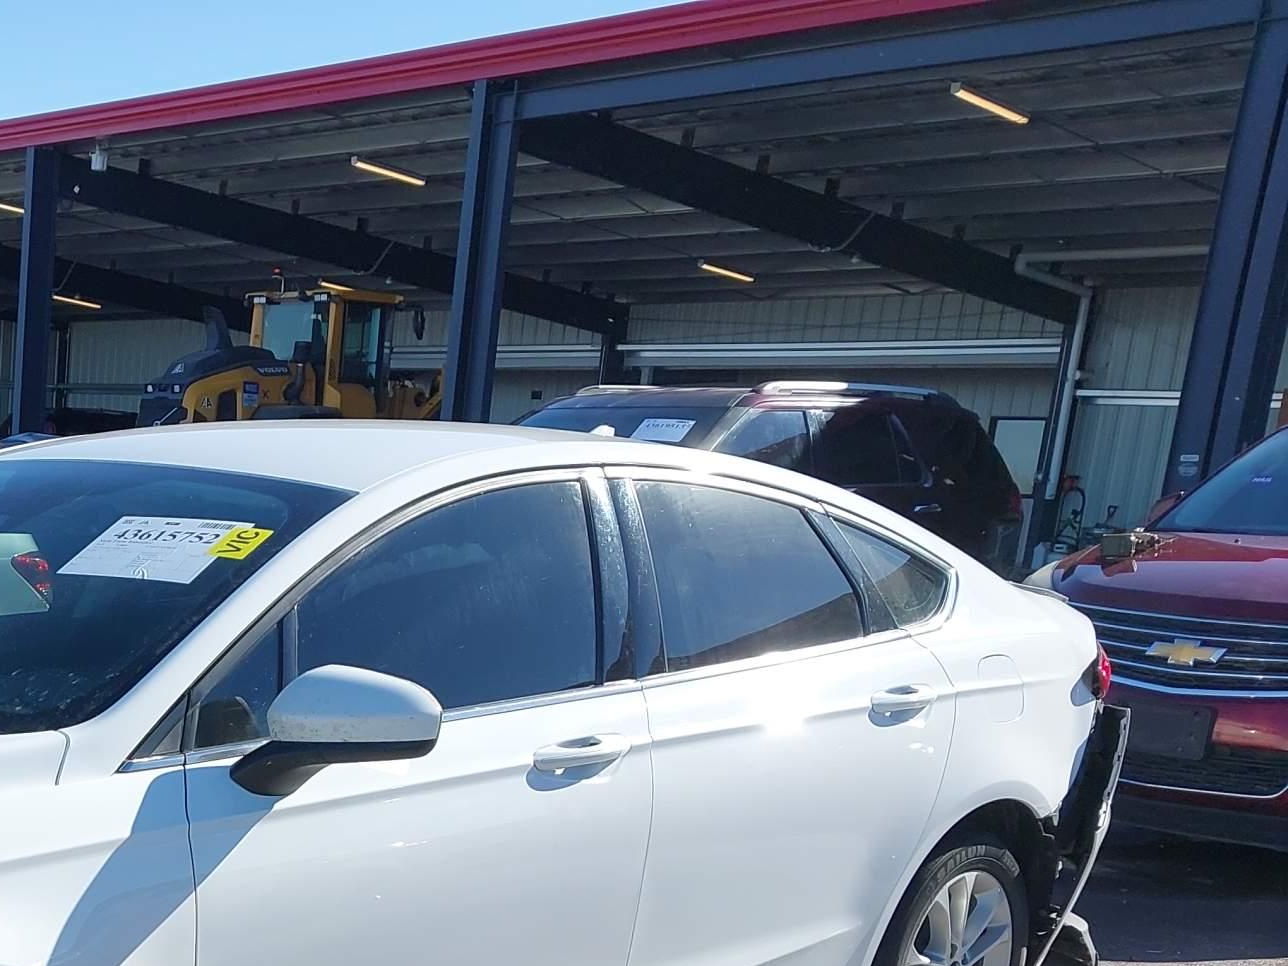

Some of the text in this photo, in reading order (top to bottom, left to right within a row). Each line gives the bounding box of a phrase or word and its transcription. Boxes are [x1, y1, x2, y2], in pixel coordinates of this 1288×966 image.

[256, 367, 289, 375] VOLVO
[114, 527, 221, 545] 43615752
[215, 530, 260, 555] VIC
